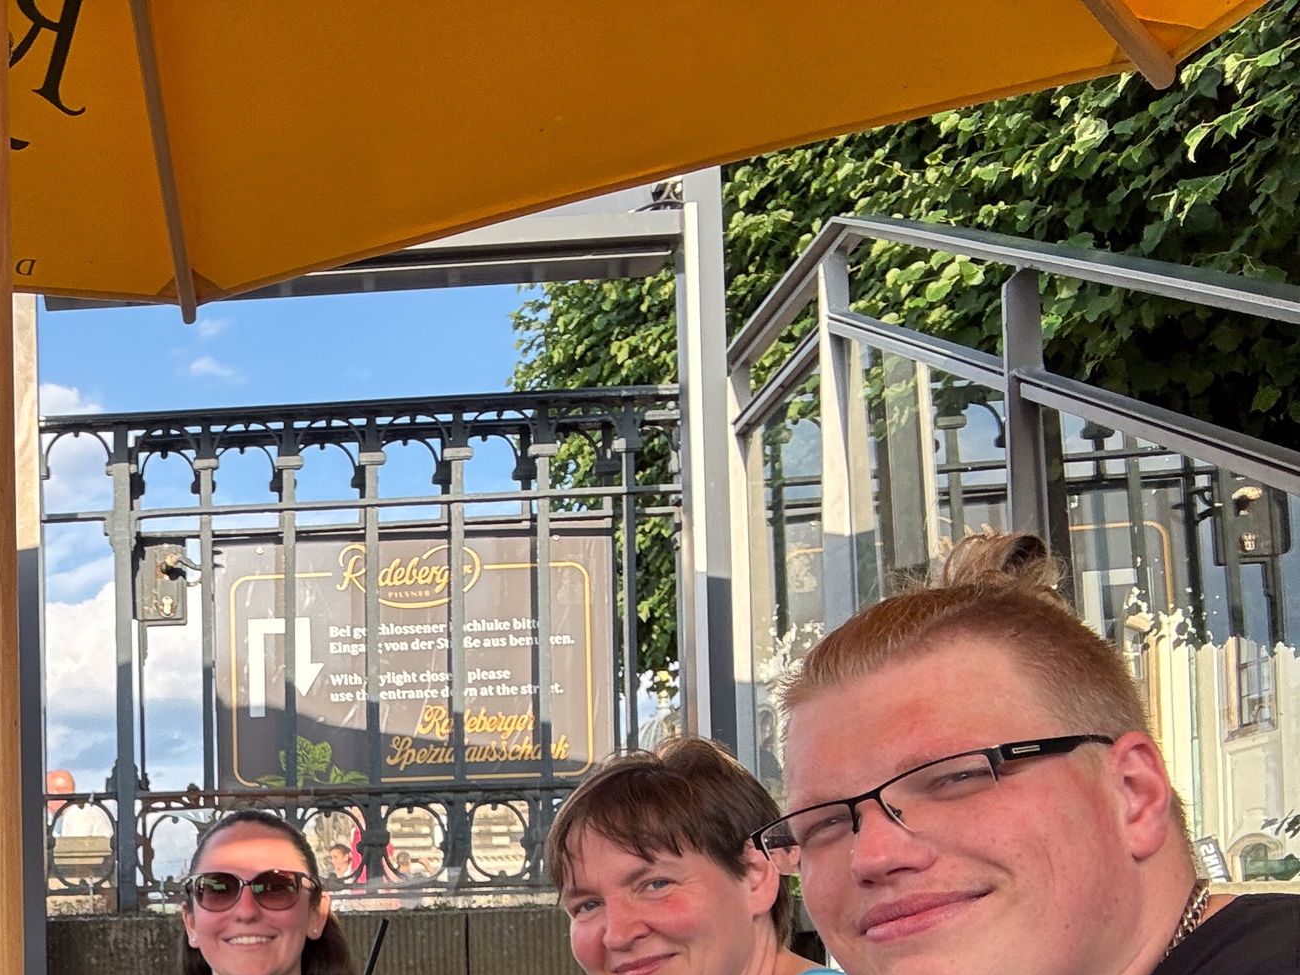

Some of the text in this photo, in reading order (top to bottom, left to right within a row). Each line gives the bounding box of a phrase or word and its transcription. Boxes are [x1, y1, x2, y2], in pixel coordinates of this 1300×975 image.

[337, 544, 480, 593] Rdebergr
[329, 626, 352, 639] Bei
[352, 623, 448, 642] gechlossener
[384, 643, 409, 652] von
[411, 637, 435, 650] der
[436, 635, 482, 650] Stße
[483, 638, 507, 648] aus
[508, 633, 575, 648] benuzen.
[329, 667, 511, 688] With ylight close please
[330, 692, 354, 703] use
[355, 688, 372, 702] th
[378, 687, 439, 702] entrance
[479, 686, 494, 697] at
[495, 683, 518, 697] the
[520, 681, 565, 697] strt.
[418, 704, 535, 740] Raeberger
